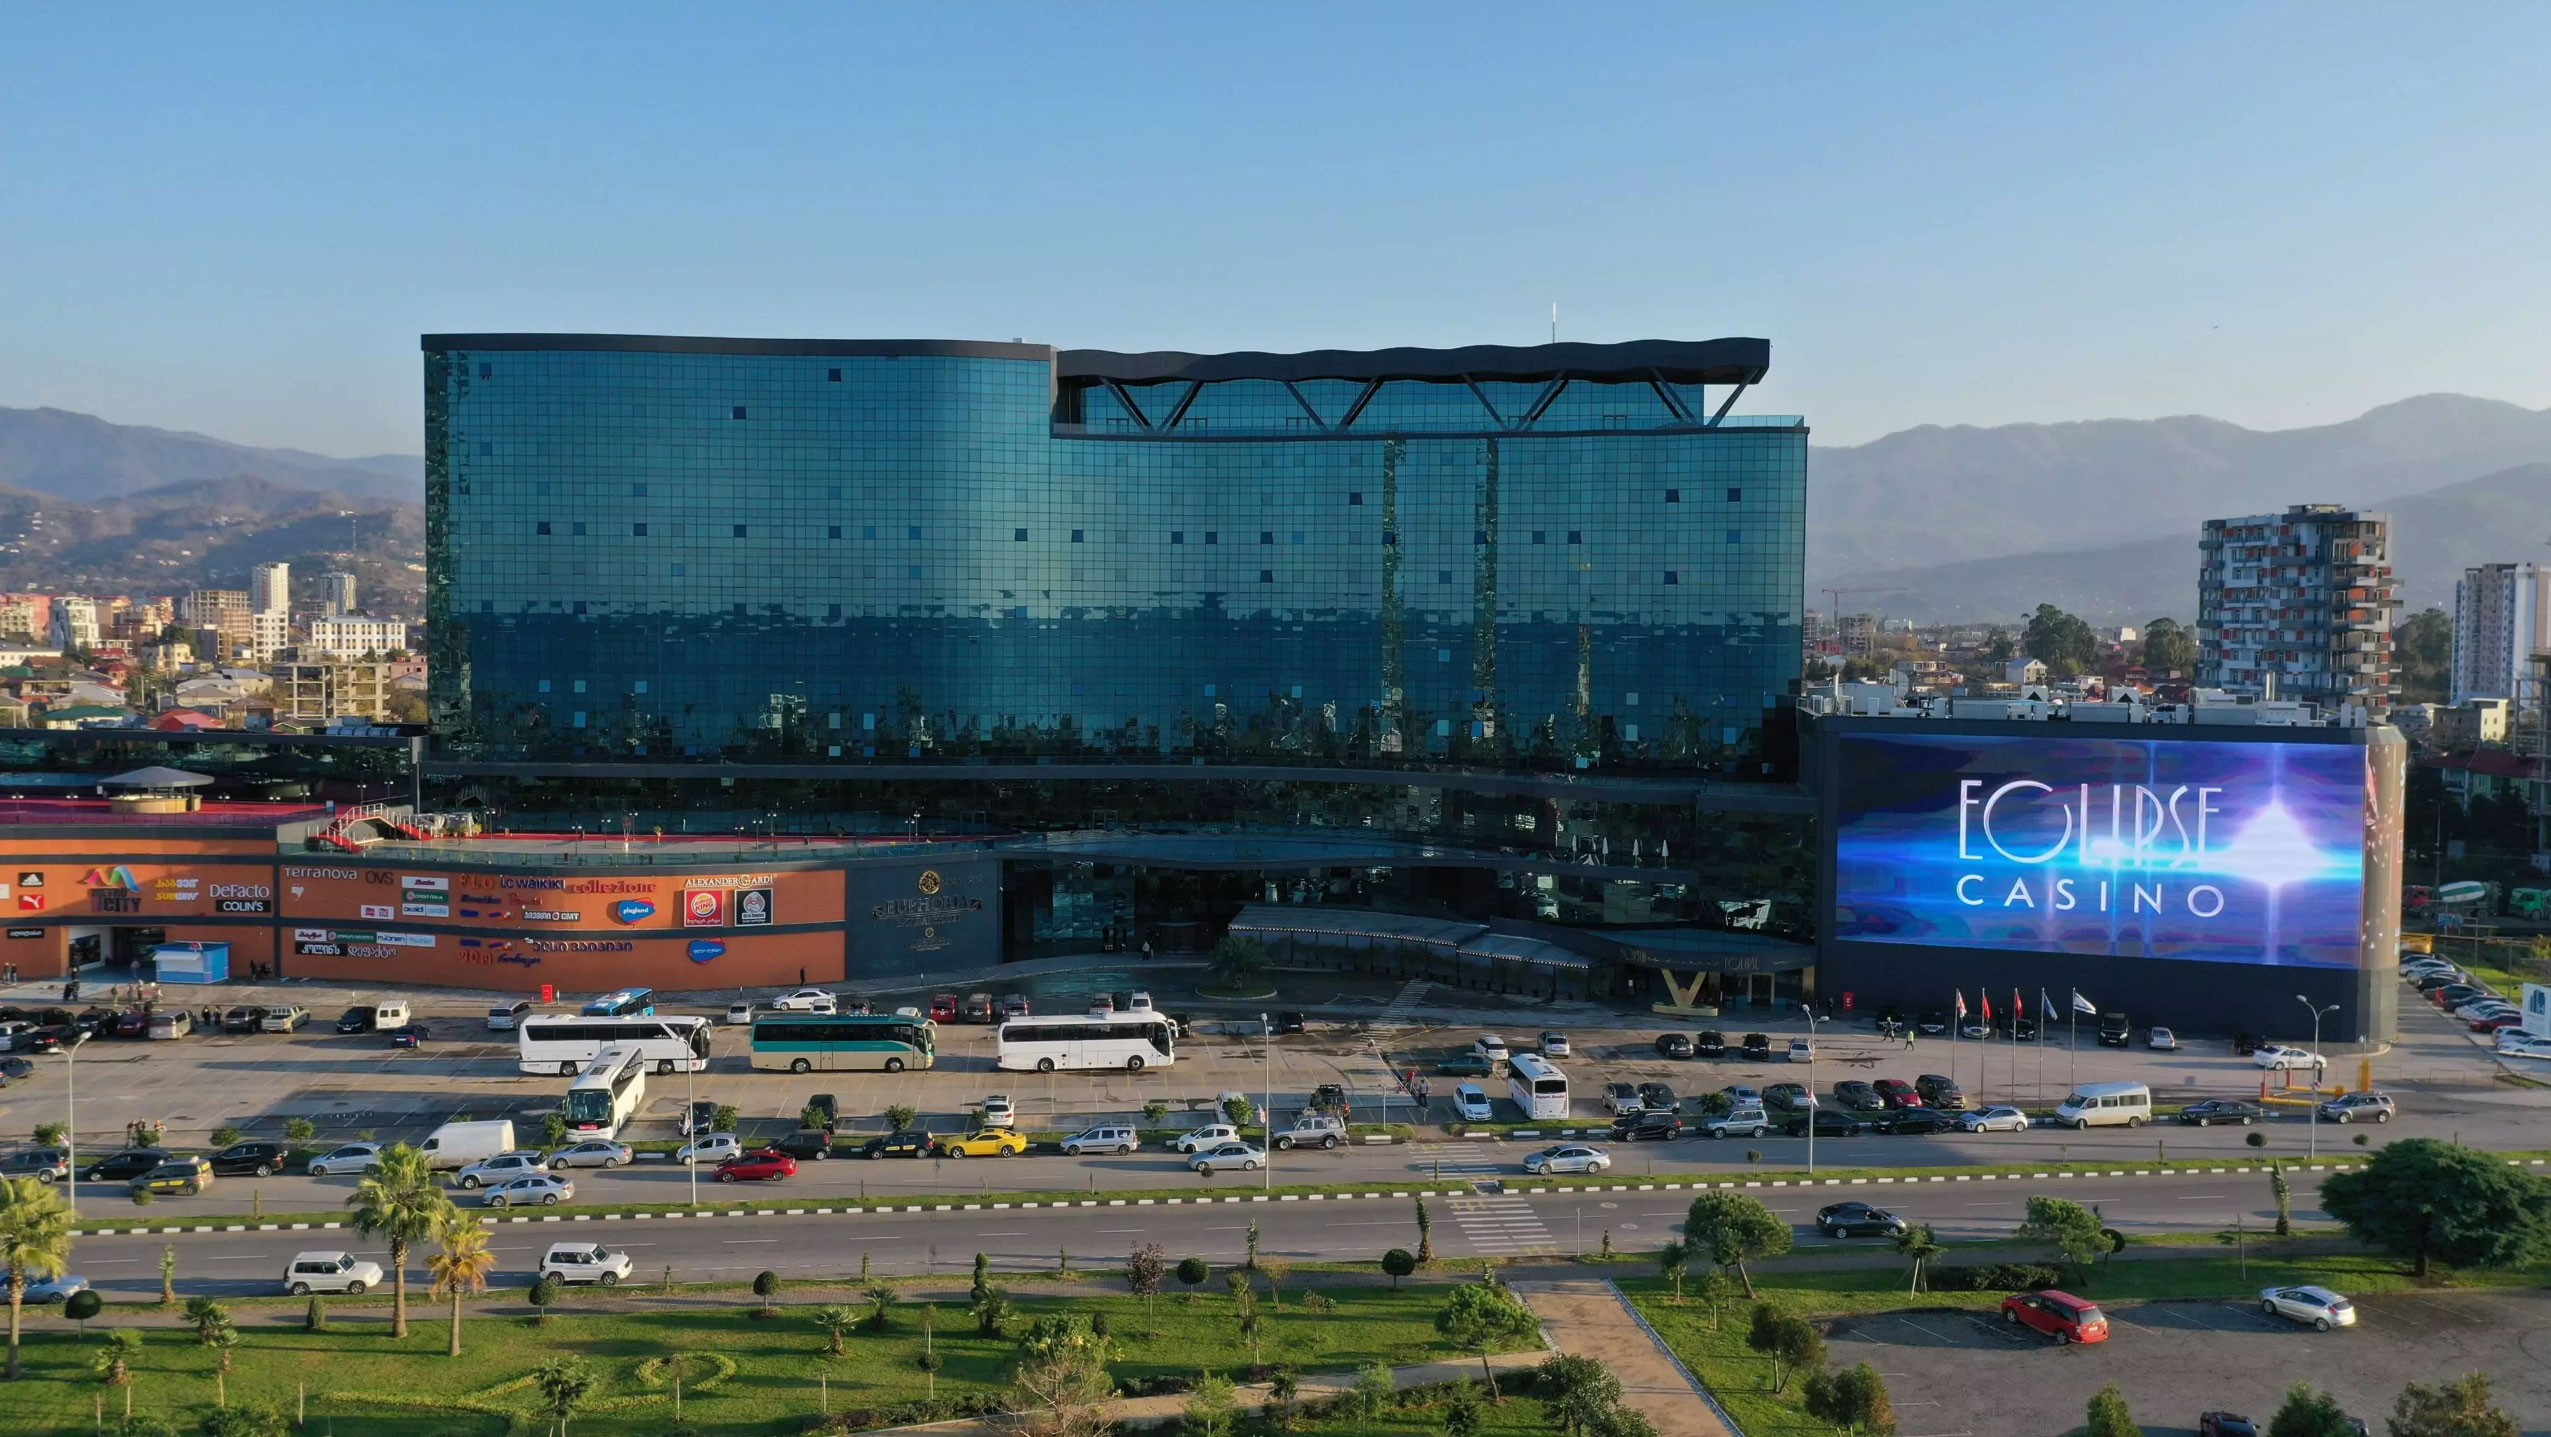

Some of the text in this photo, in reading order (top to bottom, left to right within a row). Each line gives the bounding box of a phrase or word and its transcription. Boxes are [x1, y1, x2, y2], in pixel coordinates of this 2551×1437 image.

[1959, 778, 2223, 869] ECLIPSE
[365, 870, 394, 884] OVS
[458, 874, 495, 889] FLO
[209, 884, 270, 898] DeFacto
[573, 880, 657, 893] collezione
[155, 892, 199, 901] SUBWAY
[1956, 874, 2224, 917] CASINO
[103, 897, 142, 912] CITY
[223, 901, 264, 912] COLIN'S
[623, 907, 649, 915] playland
[695, 902, 713, 911] KING
[560, 912, 579, 920] GMT
